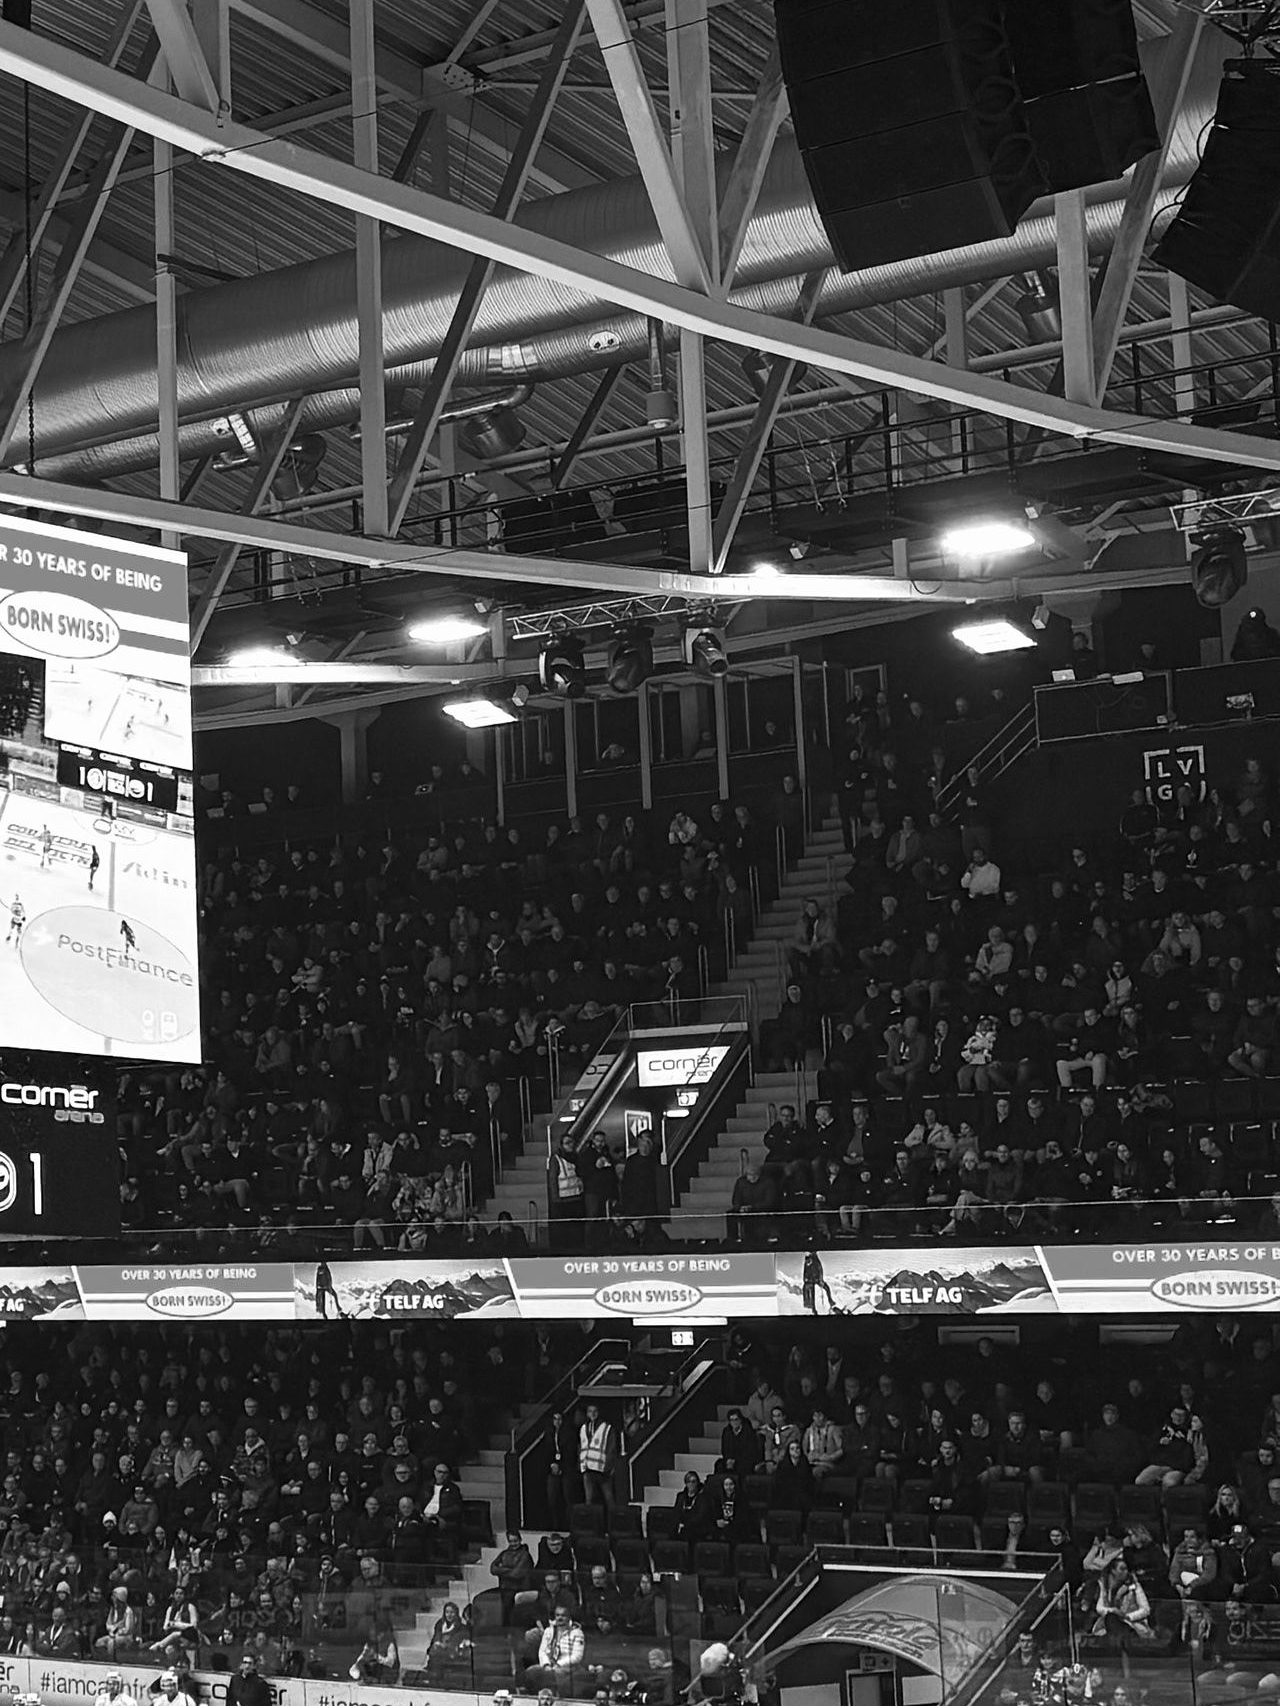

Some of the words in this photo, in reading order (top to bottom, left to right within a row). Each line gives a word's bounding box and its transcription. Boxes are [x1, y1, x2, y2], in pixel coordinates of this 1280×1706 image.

[13, 548, 32, 566] 30
[36, 551, 86, 578] YEARS
[91, 563, 111, 582] OF
[115, 568, 162, 592] BEING
[7, 605, 53, 633] BORN
[58, 614, 110, 643] SWISS!
[54, 1110, 104, 1124] arena
[30, 1153, 41, 1214] 1
[1113, 1250, 1156, 1264] OVER
[1162, 1250, 1180, 1263] 30
[1186, 1248, 1240, 1262] YEARS
[1246, 1247, 1268, 1261] OF
[564, 1262, 596, 1274] OVER
[600, 1262, 619, 1274] 30
[623, 1261, 664, 1274] YEARS
[668, 1260, 685, 1272] OF
[689, 1260, 730, 1272] BEING
[602, 1286, 641, 1303] BORN
[644, 1286, 692, 1302] SWISS!
[890, 1287, 934, 1305] TELF
[936, 1286, 963, 1304] AG
[1161, 1279, 1211, 1296] BORN
[1215, 1279, 1277, 1295] SWISS!
[5, 1297, 24, 1312] AG
[383, 1295, 420, 1309] TELF
[422, 1295, 445, 1309] AG
